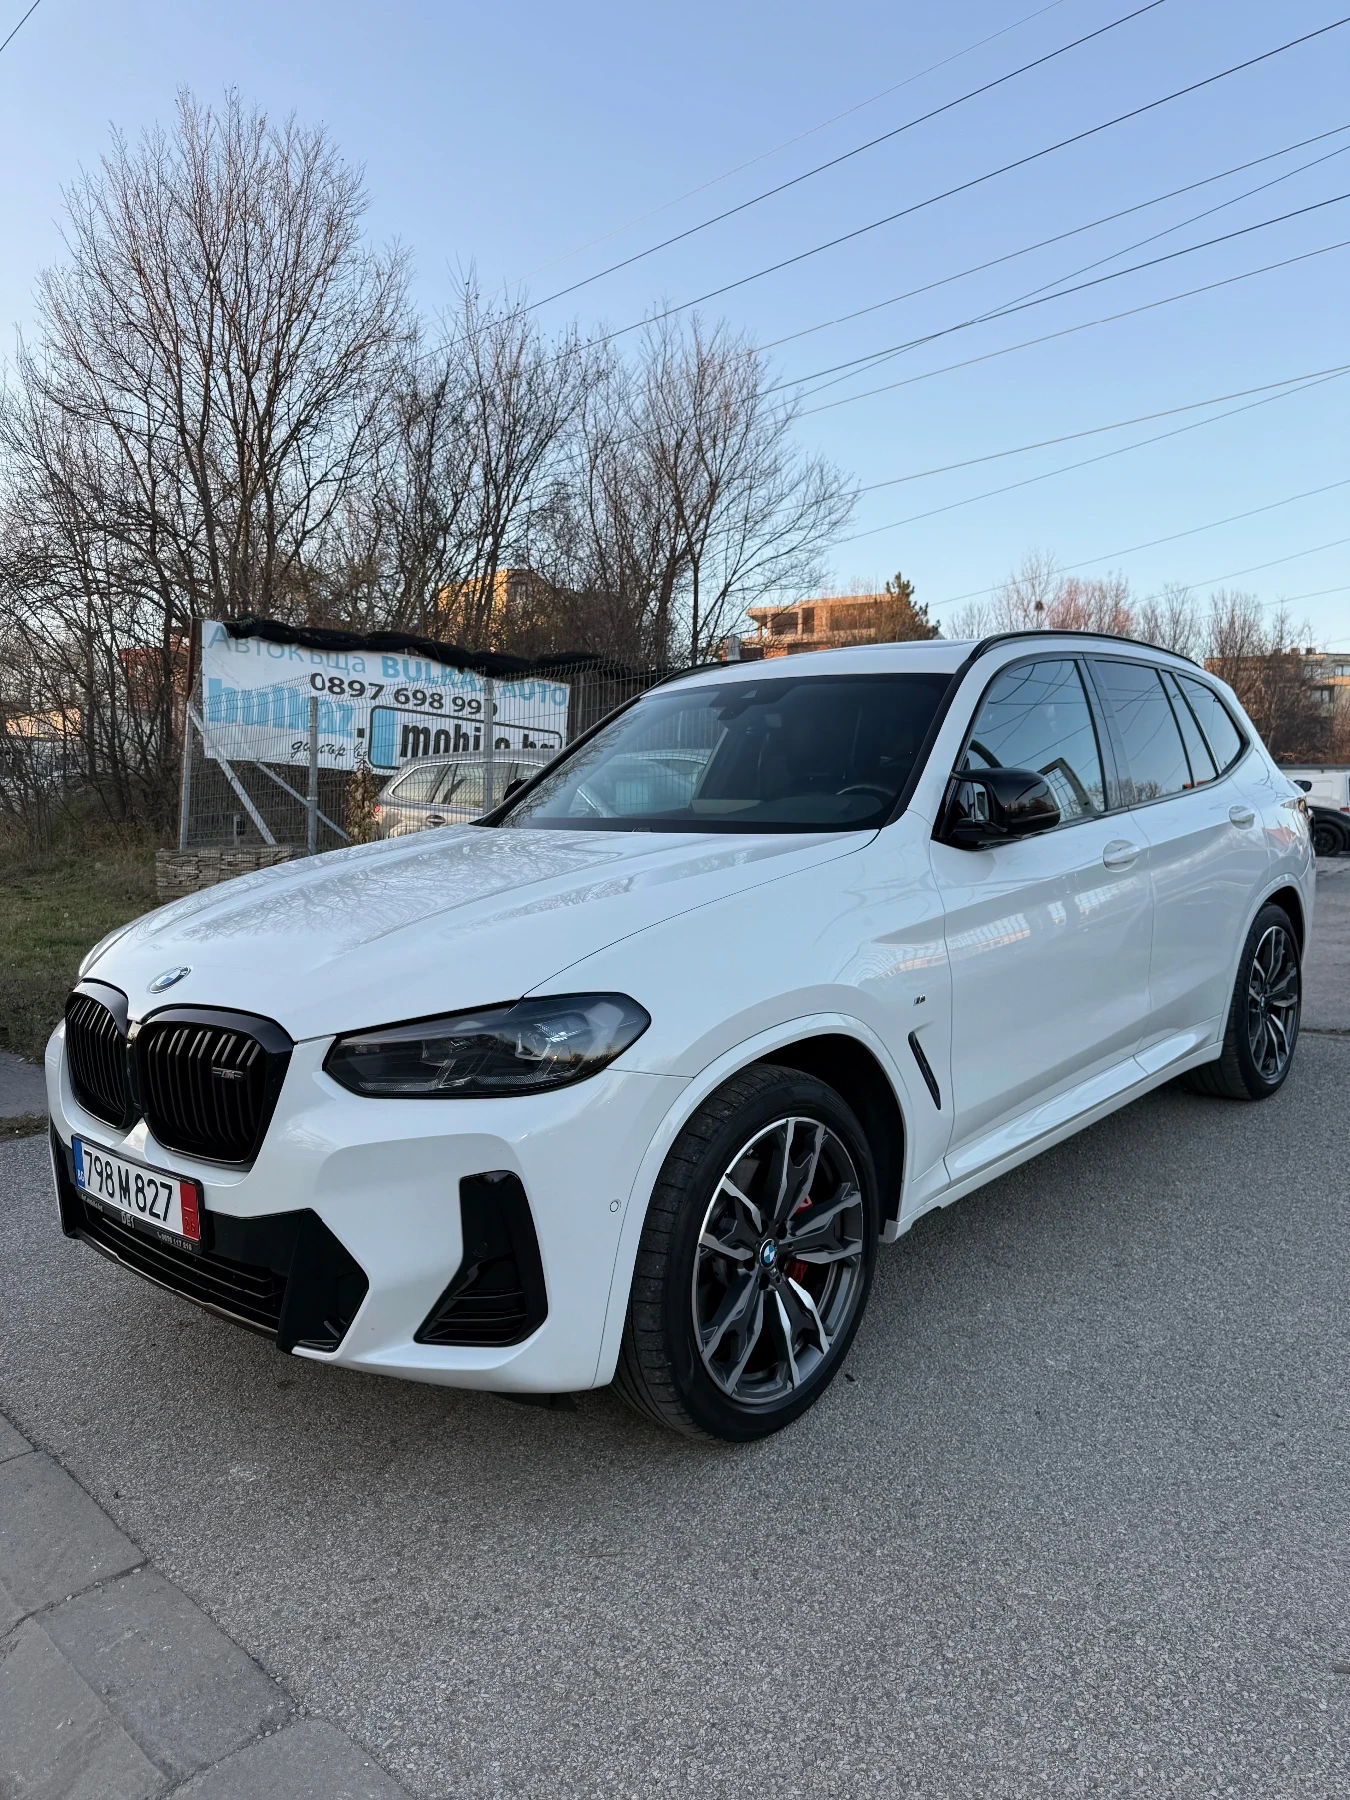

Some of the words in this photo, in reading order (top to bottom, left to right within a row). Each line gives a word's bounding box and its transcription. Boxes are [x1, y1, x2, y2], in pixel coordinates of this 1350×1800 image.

[310, 672, 385, 700] 0897
[394, 688, 444, 709] 698
[381, 655, 485, 693] BULKA
[500, 681, 567, 706] AUTO
